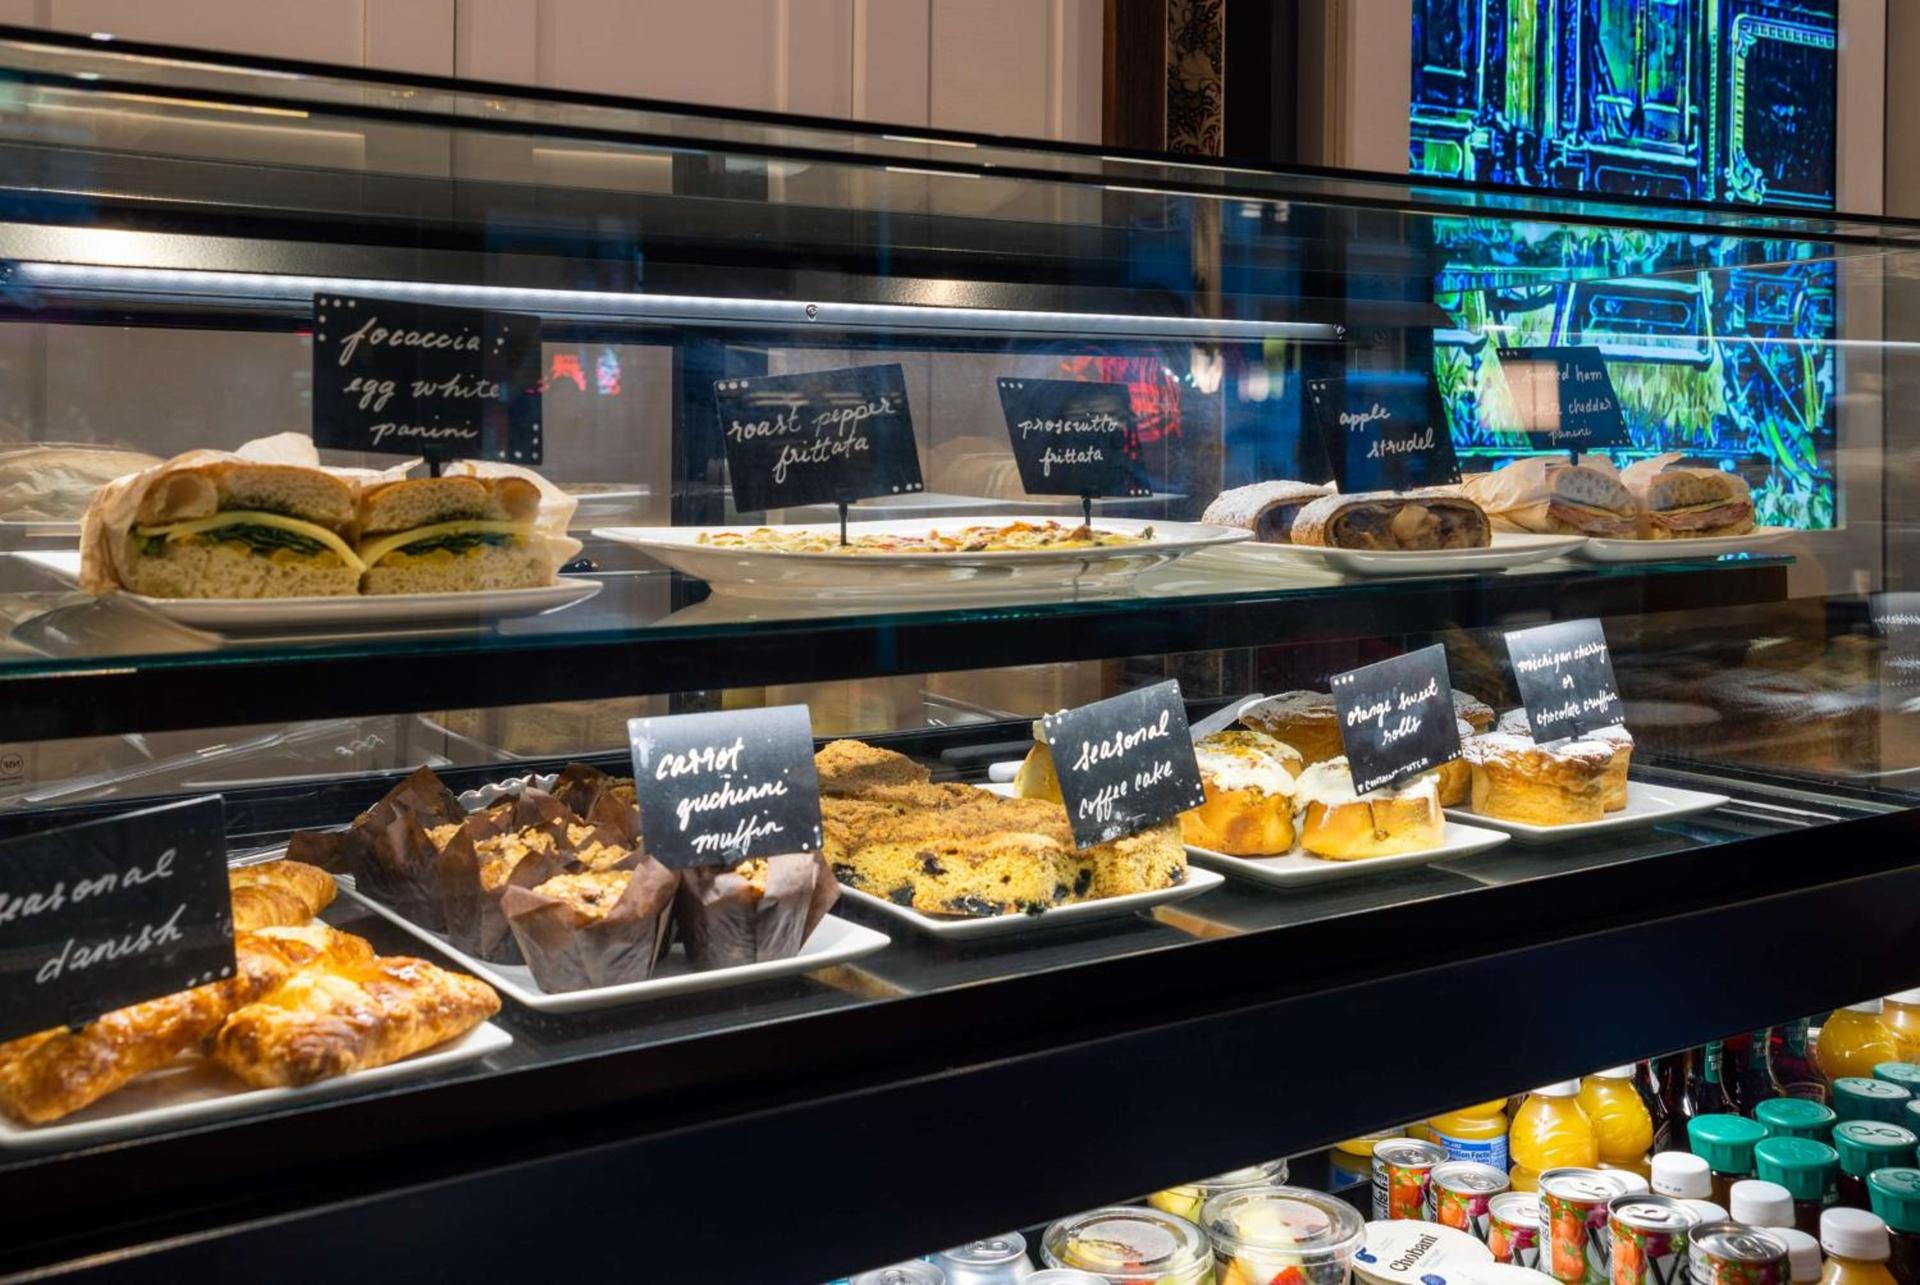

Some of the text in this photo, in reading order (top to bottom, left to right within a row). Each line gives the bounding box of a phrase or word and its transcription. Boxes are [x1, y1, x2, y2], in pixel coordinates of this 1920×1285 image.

[339, 316, 480, 366] focaccia
[343, 374, 499, 412] egg white
[1575, 364, 1602, 383] ham
[369, 415, 479, 446] panini
[727, 397, 896, 443] roast pepper
[1340, 403, 1391, 432] apple
[1548, 420, 1592, 446] panini
[772, 435, 869, 484] frittata
[1040, 446, 1104, 477] frittata
[1366, 427, 1435, 459] strudel
[1347, 676, 1438, 728] orange sweet
[1072, 709, 1170, 771] seasonal
[1382, 715, 1422, 746] rolls
[656, 737, 744, 780] carrot
[1079, 760, 1173, 823] coffee cake
[691, 810, 784, 855] muffin
[35, 903, 187, 984] danish
[1389, 1233, 1438, 1272] Chobani
